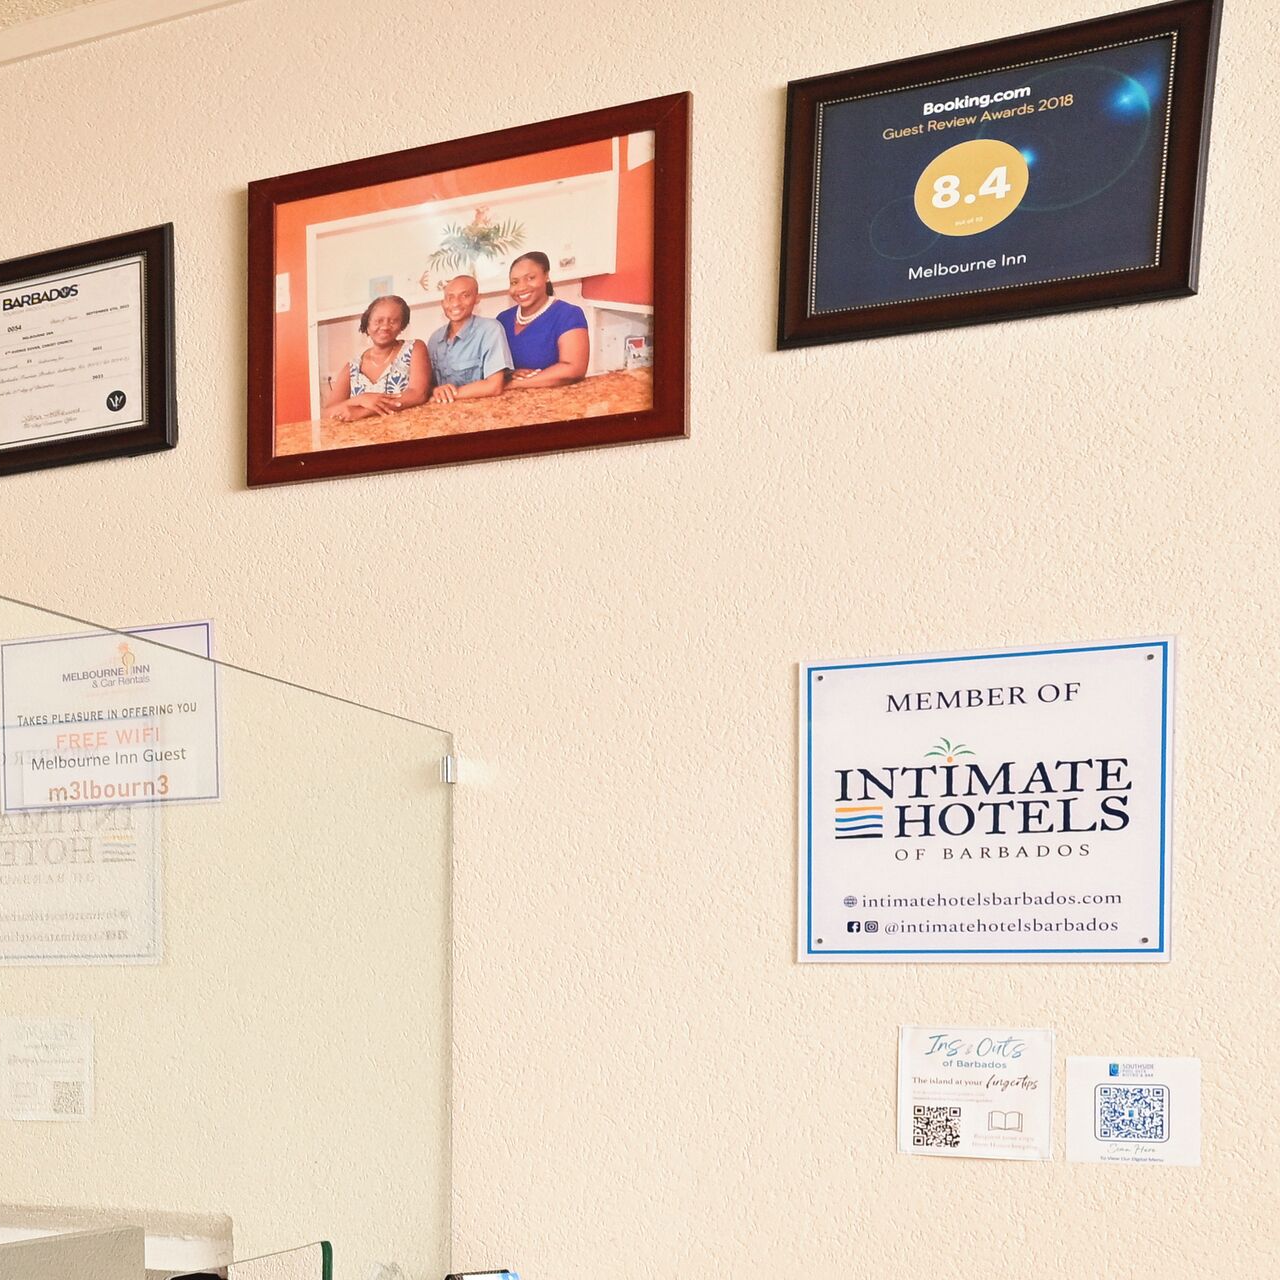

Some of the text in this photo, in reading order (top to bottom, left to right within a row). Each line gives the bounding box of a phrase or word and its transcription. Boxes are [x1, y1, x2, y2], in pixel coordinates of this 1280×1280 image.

[923, 86, 1031, 116] Booking.com
[883, 94, 1074, 140] Guest Review Awards 2018
[931, 165, 1011, 209] 8.4
[908, 254, 1027, 281] Melbourne Inn
[2, 284, 79, 311] BARBADOS
[62, 664, 150, 682] MELBOURNE INN
[91, 674, 150, 689] & Car Rentals
[886, 682, 1081, 713] MEMBER OF
[17, 702, 197, 727] TAKES PLEASURE IN OFFERING YOU
[56, 727, 160, 749] FREE WIFI
[31, 755, 110, 771] Melbourne
[115, 751, 138, 766] Inn
[143, 747, 187, 763] Guest
[48, 774, 170, 802] m3lbourn3
[835, 758, 1132, 801] INTIMATE
[894, 795, 1130, 838] HOTELS
[895, 843, 1091, 861] OF BARBADOS
[862, 891, 1122, 908] intimatehotelsbarbados.com
[885, 917, 1119, 934] @intimatehotelsbarbados
[925, 1034, 966, 1057] Ins
[942, 1060, 1007, 1069] of Barbados
[912, 1077, 927, 1085] The
[929, 1077, 953, 1085] island
